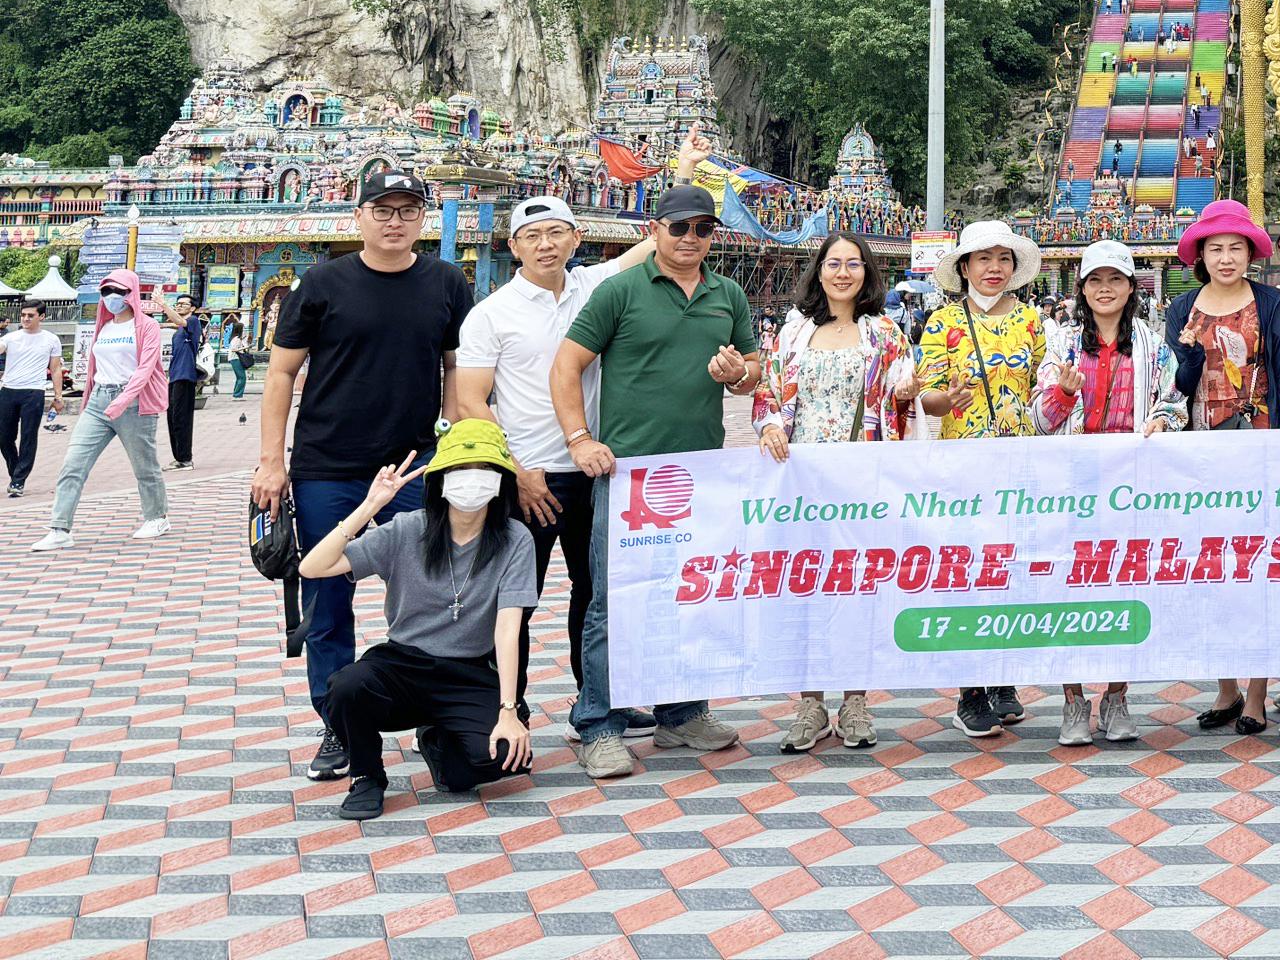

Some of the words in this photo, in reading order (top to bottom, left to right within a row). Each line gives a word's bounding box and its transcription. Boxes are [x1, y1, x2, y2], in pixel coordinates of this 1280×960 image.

[741, 495, 889, 526] Welcome
[899, 491, 983, 519] Nhat
[995, 487, 1098, 519] Thang
[1108, 485, 1263, 515] Company
[619, 534, 672, 548] SUNRISE
[675, 533, 692, 543] CO
[918, 617, 951, 638] 17
[974, 610, 1131, 640] 20/04/2024
